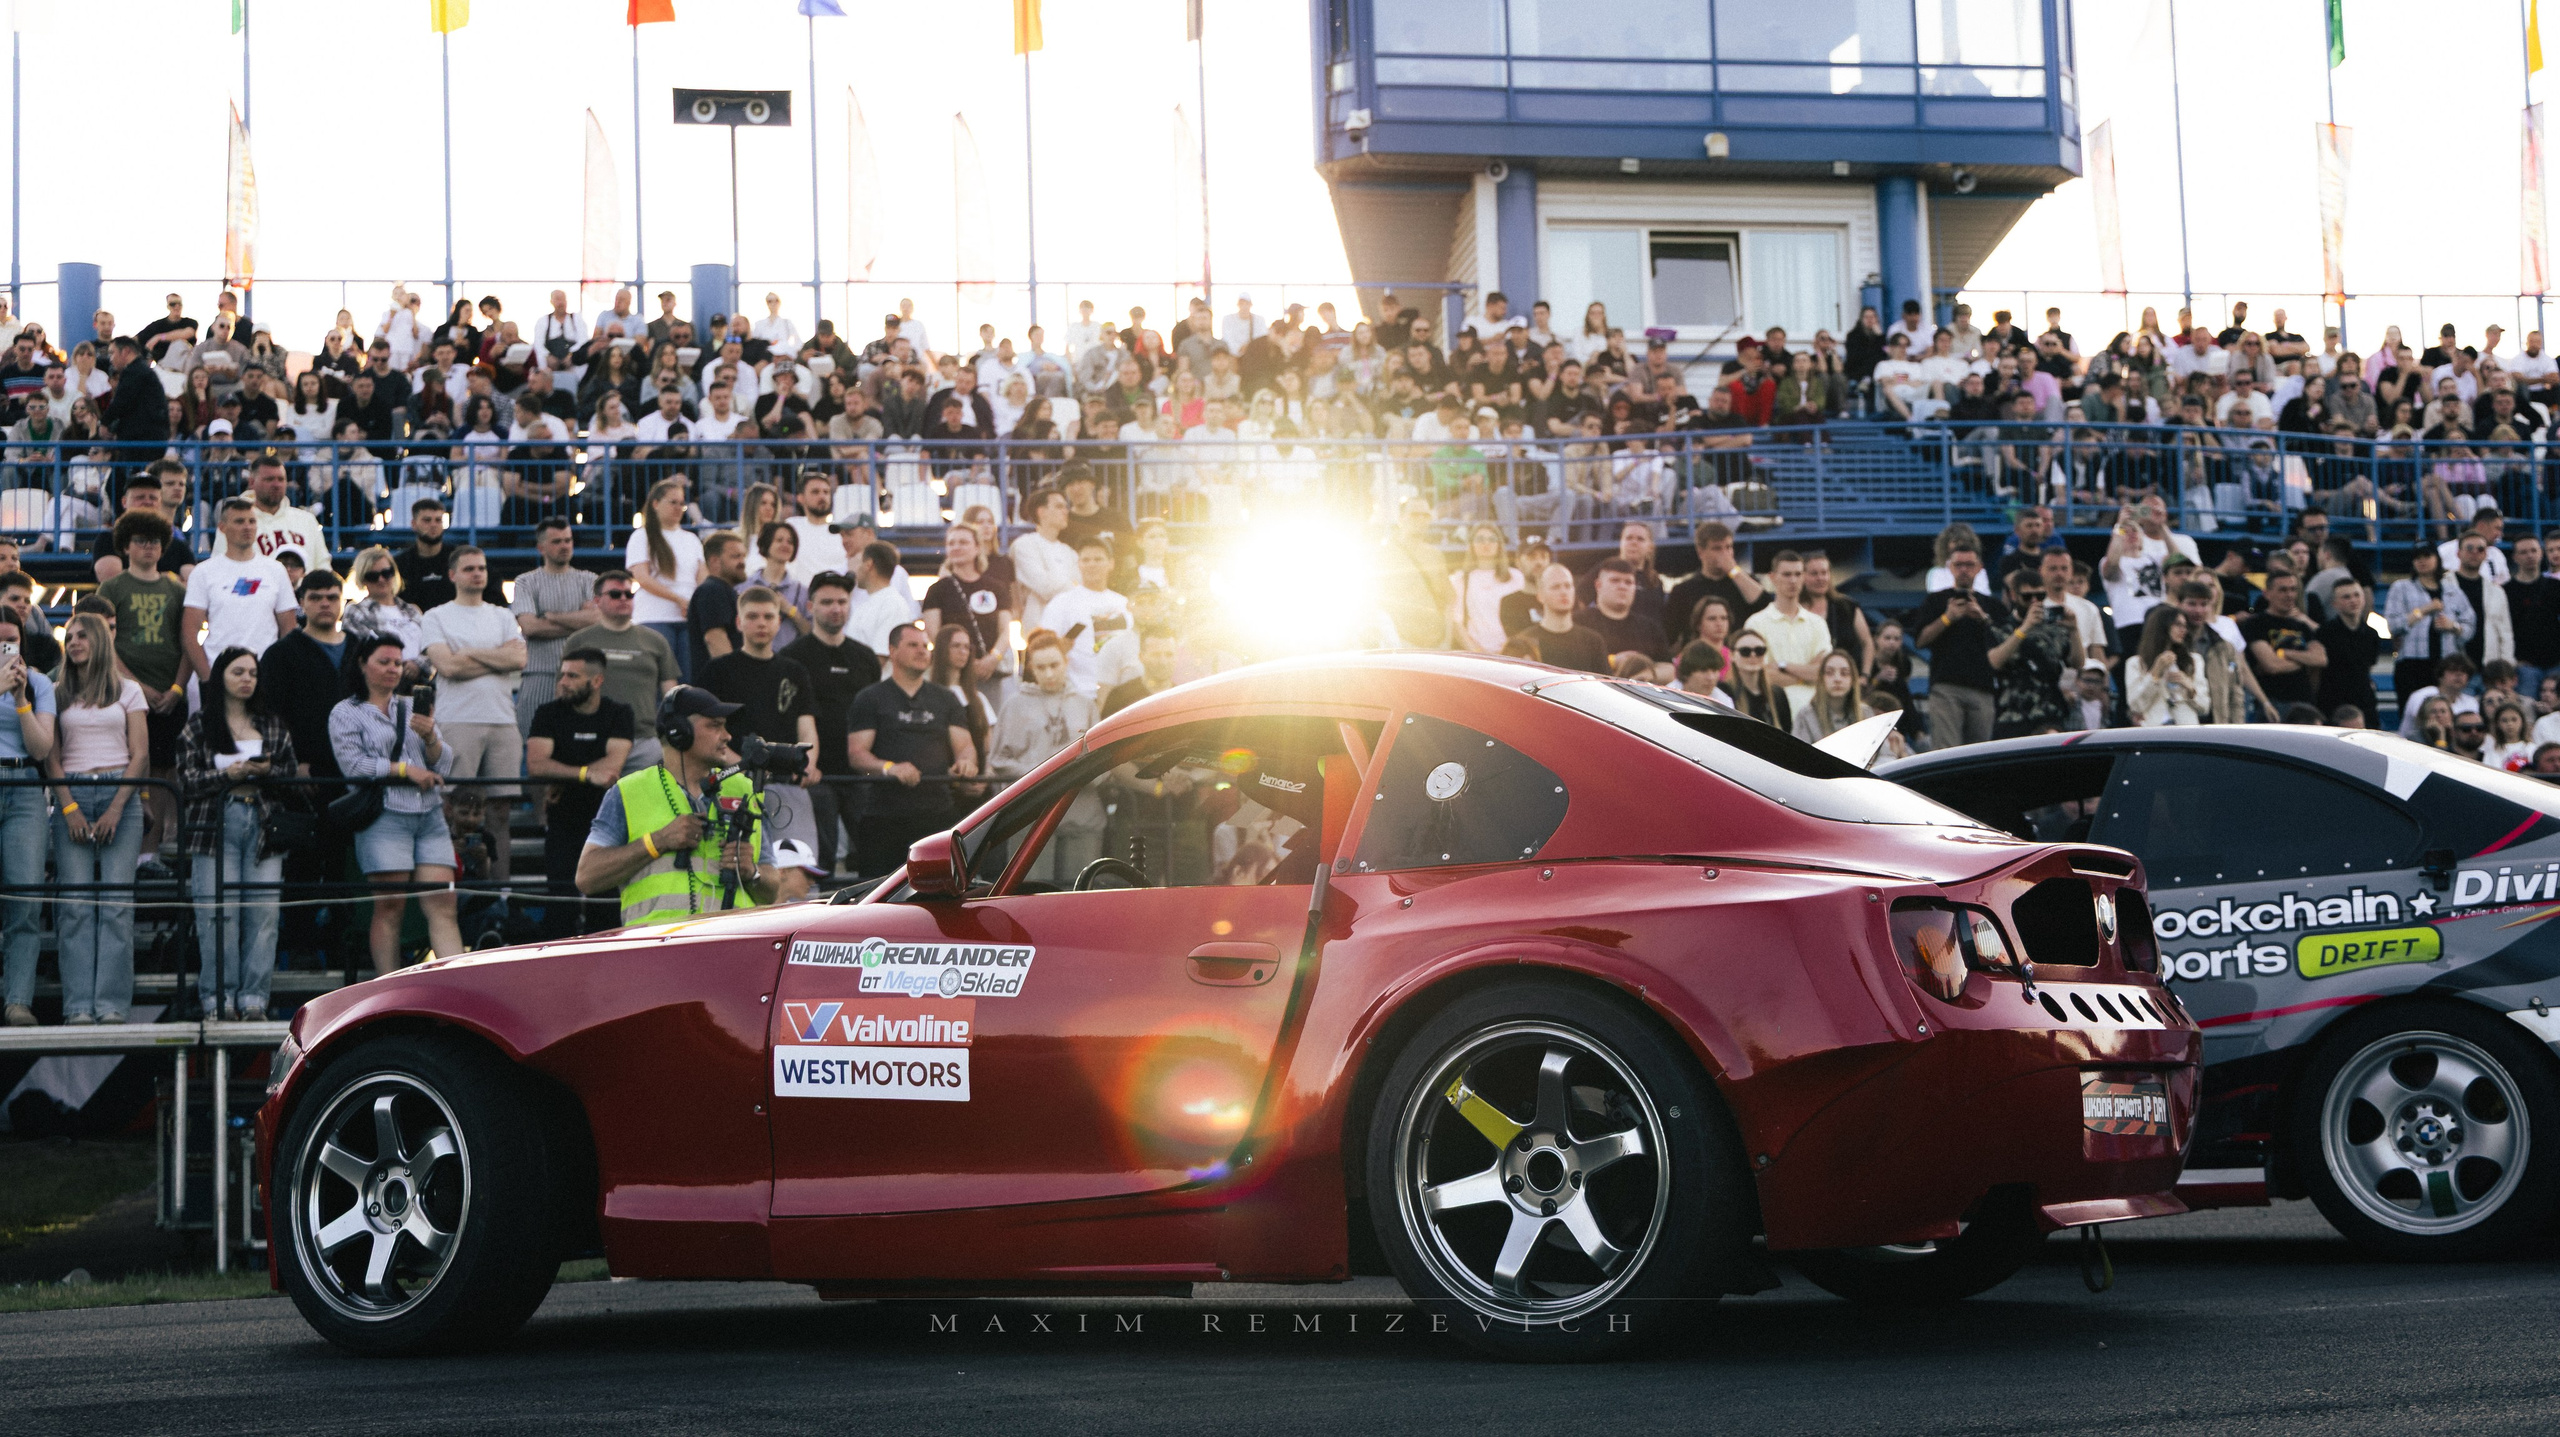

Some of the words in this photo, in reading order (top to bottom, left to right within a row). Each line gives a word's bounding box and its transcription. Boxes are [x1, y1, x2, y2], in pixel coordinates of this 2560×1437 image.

[130, 593, 167, 610] JUST
[138, 609, 164, 626] DO
[716, 764, 740, 781] RONIN
[2153, 888, 2399, 939] ockchain
[791, 943, 811, 962] НА
[812, 944, 864, 965] ШИНАХ
[861, 941, 1032, 969] GRENLANDER
[2319, 937, 2420, 968] DRIFT
[883, 970, 938, 993] Mega
[960, 971, 1022, 994] Sklad
[841, 1014, 970, 1043] Valvoline
[780, 1058, 962, 1088] WESTMOTORS
[2083, 1097, 2113, 1118] ШКОЛА
[2143, 1095, 2152, 1122] JP
